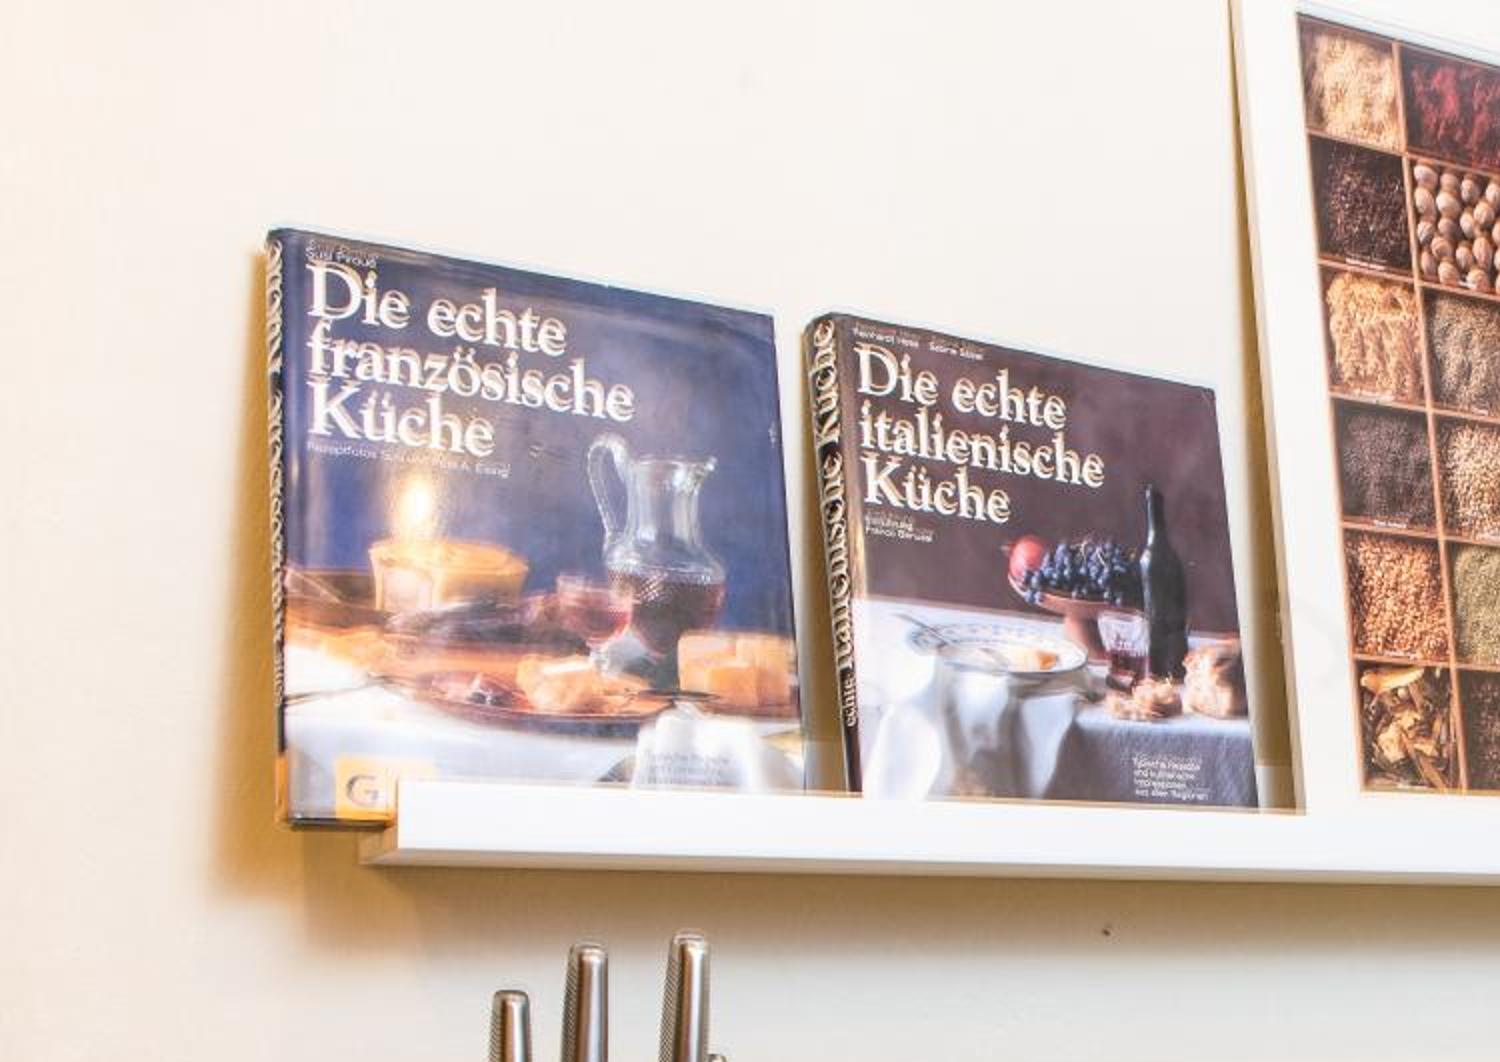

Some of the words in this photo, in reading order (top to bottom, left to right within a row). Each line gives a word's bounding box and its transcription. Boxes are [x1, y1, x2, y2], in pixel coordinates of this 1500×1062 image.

[306, 261, 411, 330] Die
[427, 287, 567, 357] echte
[306, 319, 636, 422] französische
[809, 320, 841, 445] Küche
[853, 342, 939, 405] Die
[952, 368, 1067, 429] echte
[306, 376, 496, 457] Küche
[859, 399, 1105, 488] italienische
[861, 451, 1011, 523] Küche
